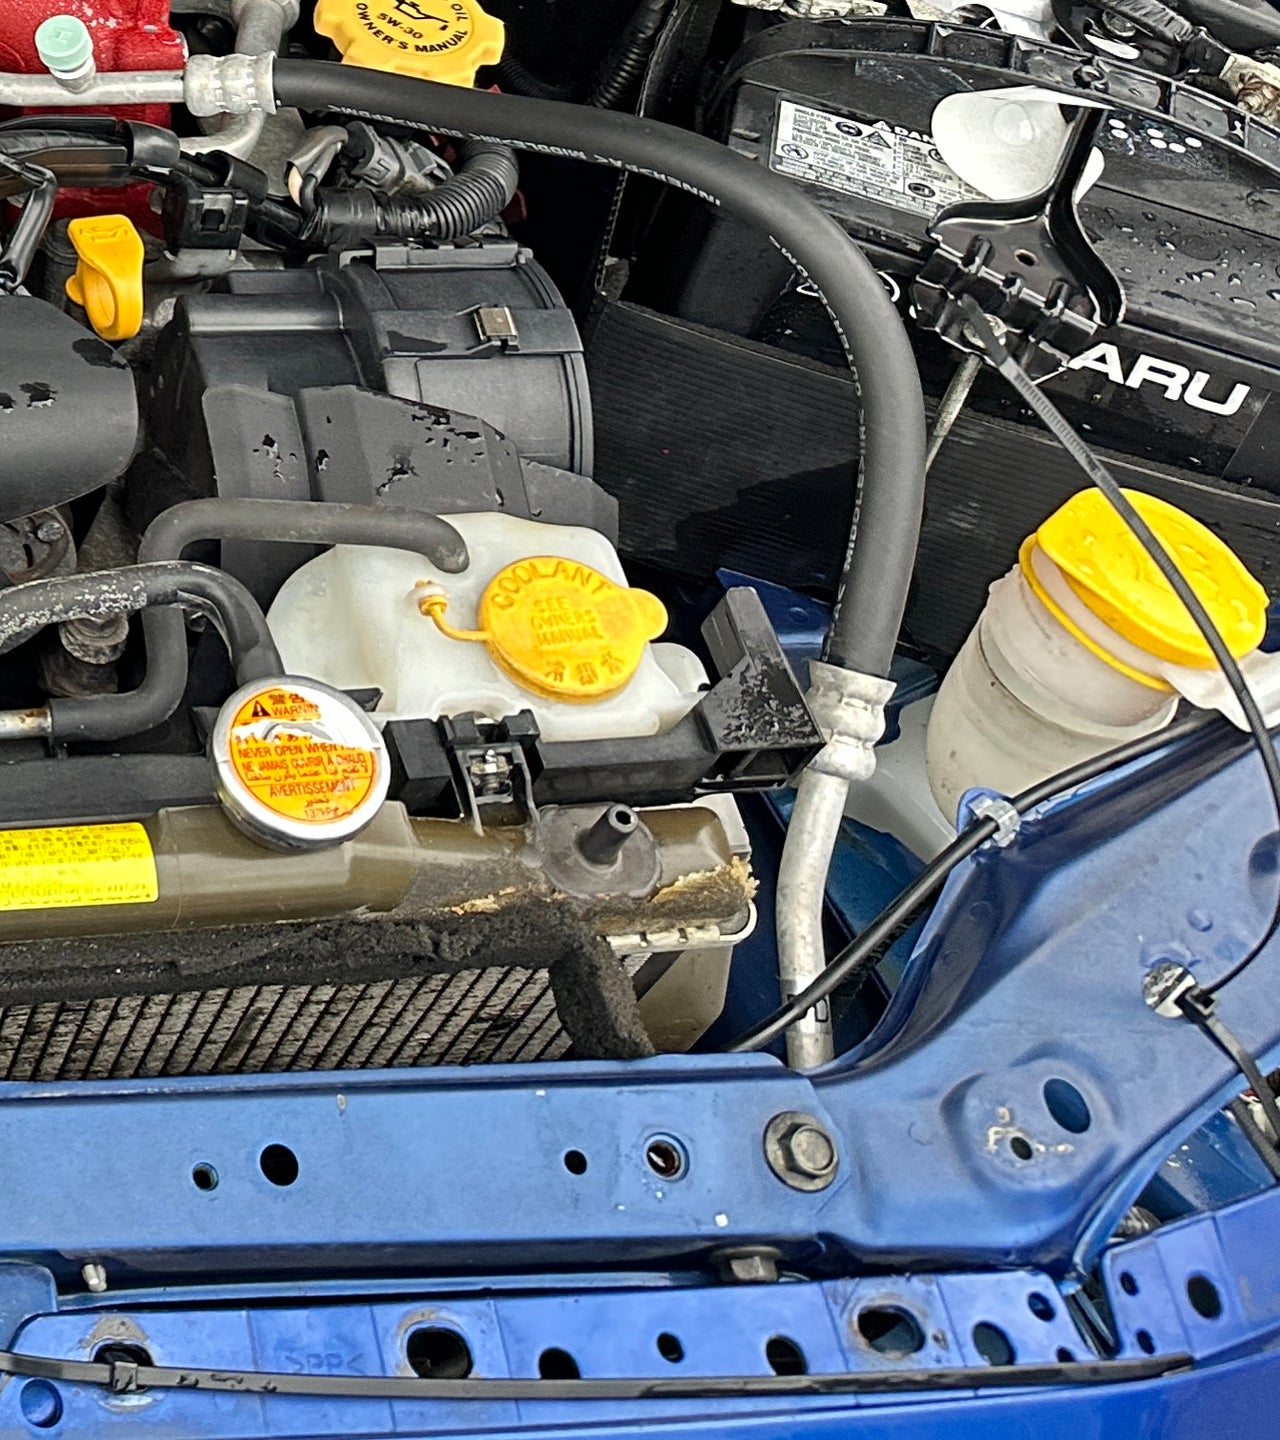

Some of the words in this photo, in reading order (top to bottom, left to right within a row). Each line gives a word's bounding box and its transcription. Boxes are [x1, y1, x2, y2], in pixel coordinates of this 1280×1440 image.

[450, 3, 469, 22] OIL
[356, 2, 409, 50] OWNER'S
[414, 30, 468, 53] MANUAL
[377, 12, 424, 40] 5W-30
[490, 560, 611, 610] COOLANT
[533, 596, 569, 613] SEE
[270, 704, 320, 717] WARNIN
[238, 745, 272, 759] NEVER
[275, 744, 303, 756] OPEN
[305, 742, 338, 753] WHEN
[241, 762, 253, 772] NE
[258, 759, 290, 772] JAMAIS
